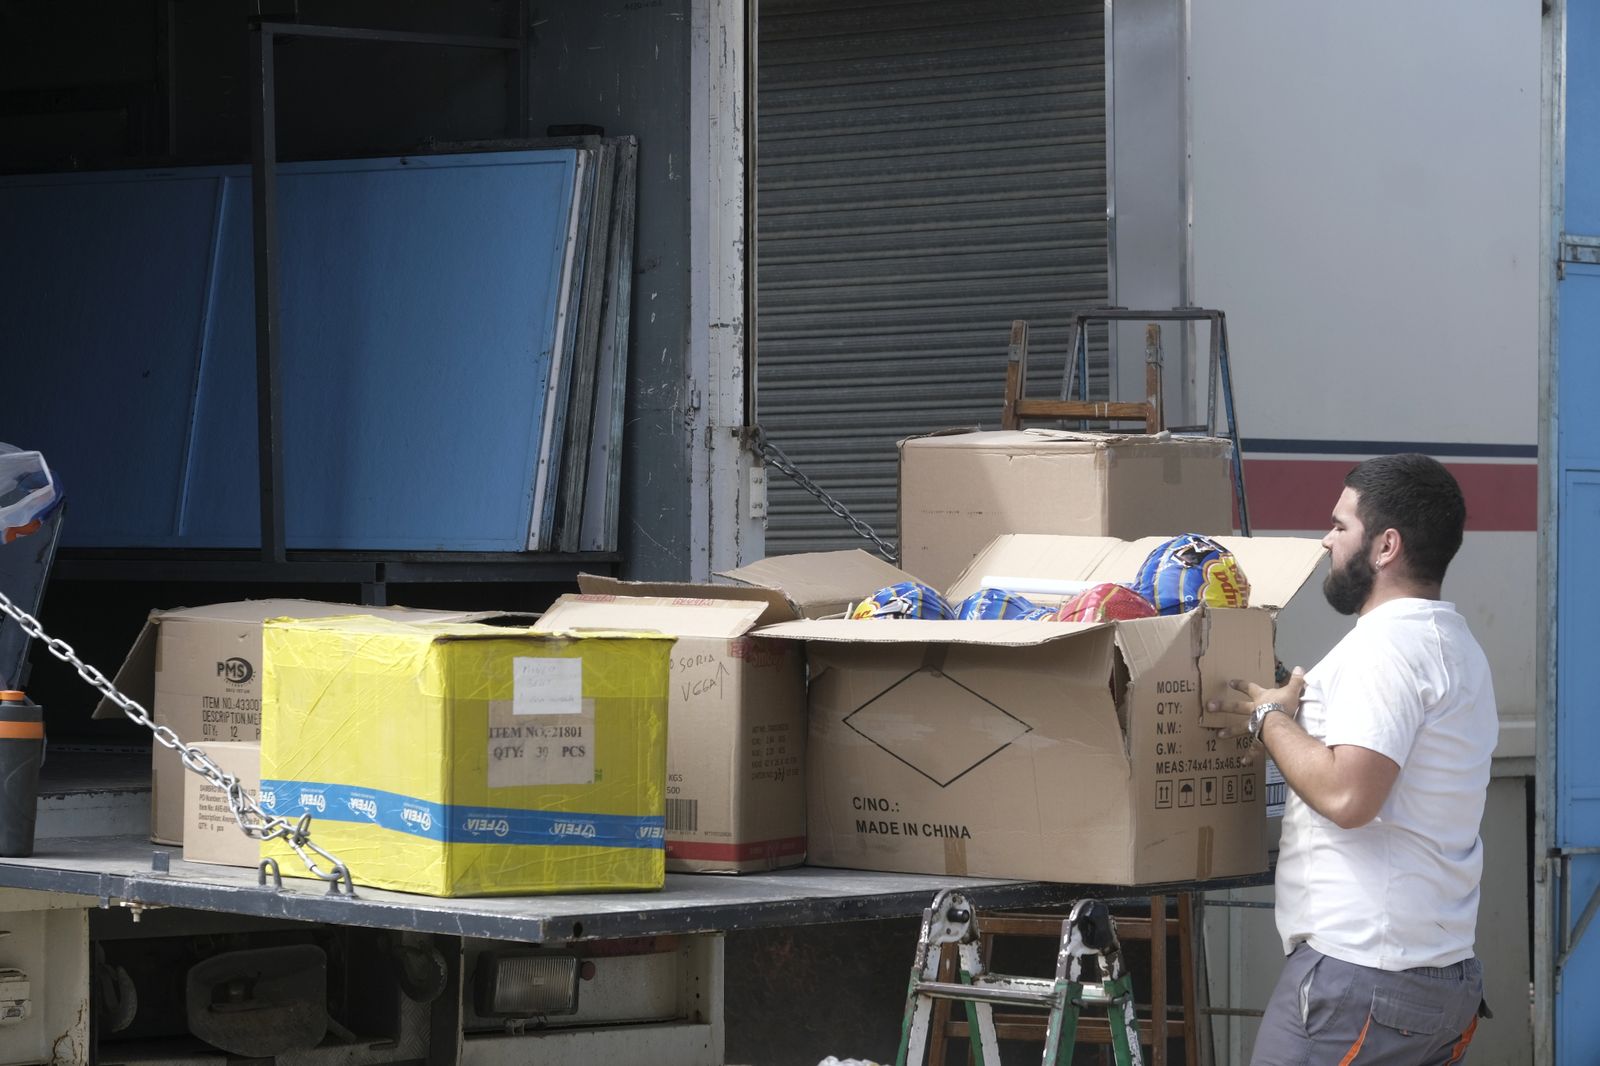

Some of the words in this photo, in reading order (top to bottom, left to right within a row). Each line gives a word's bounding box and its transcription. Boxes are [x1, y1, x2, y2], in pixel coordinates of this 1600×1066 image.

[216, 661, 245, 678] PMS
[679, 654, 715, 672] SORIA
[1156, 680, 1195, 694] MODEL:
[202, 696, 220, 709] ITEM
[1156, 702, 1183, 715] Q'TY:
[230, 726, 238, 738] 12
[488, 726, 522, 739] ITEM
[1156, 722, 1182, 735] N.W.:
[493, 747, 524, 760] QTY:
[562, 745, 586, 758] PCS
[1156, 742, 1182, 755] G.W.:
[1206, 739, 1217, 752] 12
[668, 774, 683, 783] KGS
[855, 819, 900, 835] MADE
[902, 822, 919, 836] IN
[922, 823, 972, 840] CHINA
